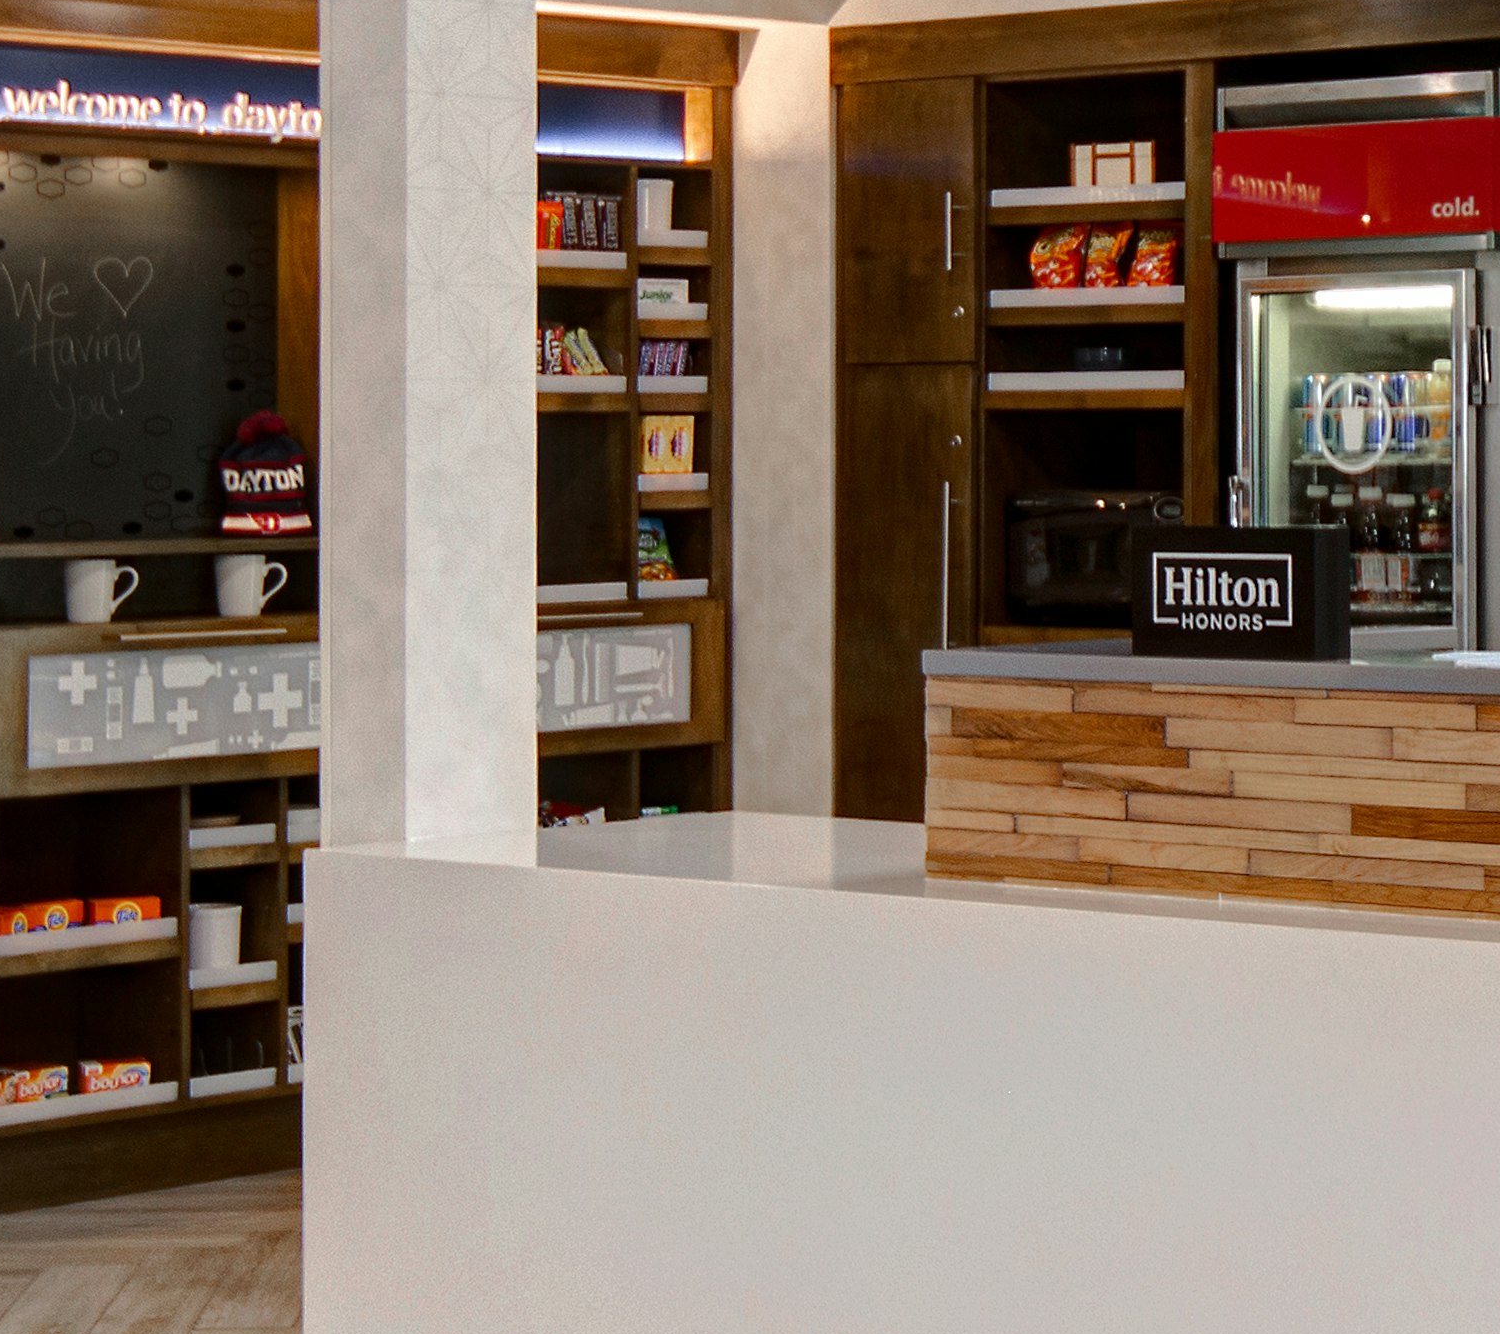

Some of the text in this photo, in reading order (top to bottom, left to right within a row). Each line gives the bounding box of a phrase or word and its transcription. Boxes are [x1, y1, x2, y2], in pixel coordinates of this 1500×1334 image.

[3, 79, 323, 143] welcome to dayto
[1431, 196, 1480, 218] cold.
[2, 257, 78, 321] We
[640, 289, 673, 303] Junior
[18, 319, 144, 394] Having
[222, 465, 304, 492] DAYTON
[1164, 567, 1281, 607] Hilton
[1181, 613, 1264, 631] HONORS
